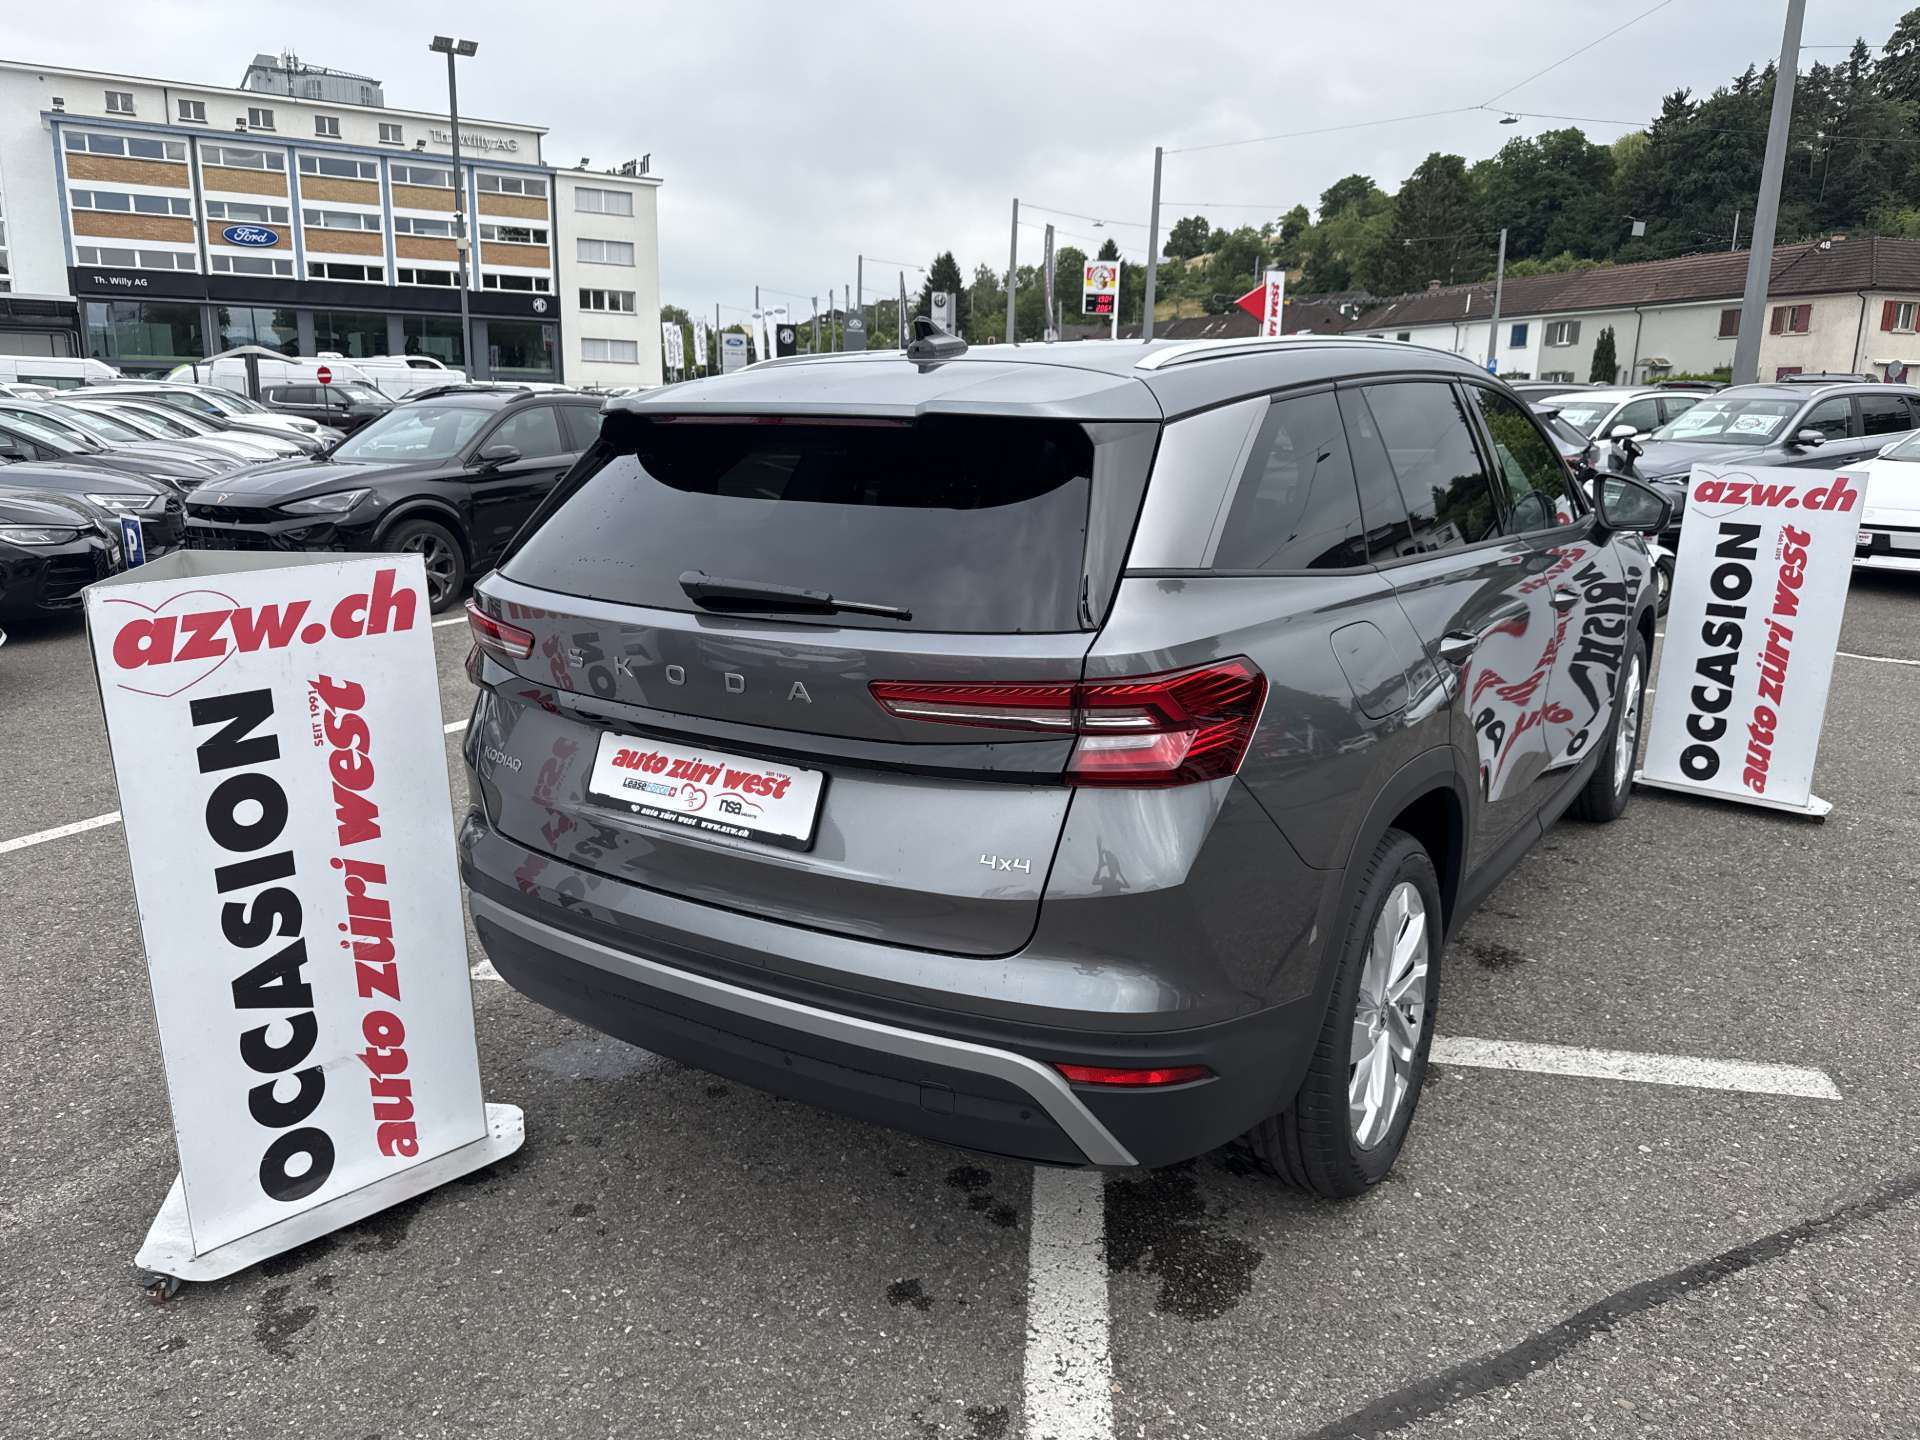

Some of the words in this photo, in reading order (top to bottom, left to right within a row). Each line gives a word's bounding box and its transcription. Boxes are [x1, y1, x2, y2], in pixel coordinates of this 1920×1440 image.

[459, 131, 493, 152] Willy
[496, 136, 519, 152] AG
[1820, 240, 1831, 250] 48
[93, 275, 108, 284] Th.
[109, 276, 132, 288] Willy
[134, 278, 148, 287] AG
[1695, 478, 1857, 512] azw.ch
[126, 527, 138, 563] P
[1773, 525, 1810, 616] west
[113, 569, 417, 669] azw.ch
[1680, 522, 1762, 781] OCCASION
[1756, 617, 1793, 706] züri
[308, 690, 320, 719] 1991
[312, 722, 324, 748] SEIT
[1743, 705, 1777, 793] auto
[307, 674, 380, 846] west
[485, 745, 522, 772] KODIAQ
[612, 749, 669, 775] auto
[666, 757, 726, 785] züri
[722, 768, 792, 800] west
[641, 807, 659, 817] auto
[659, 811, 678, 821] züri
[678, 815, 698, 826] west
[718, 799, 742, 815] nsa
[979, 854, 1031, 874] 4x4
[189, 688, 335, 1202] OCCASION
[331, 857, 400, 1000] züri
[356, 1011, 419, 1158] auto
